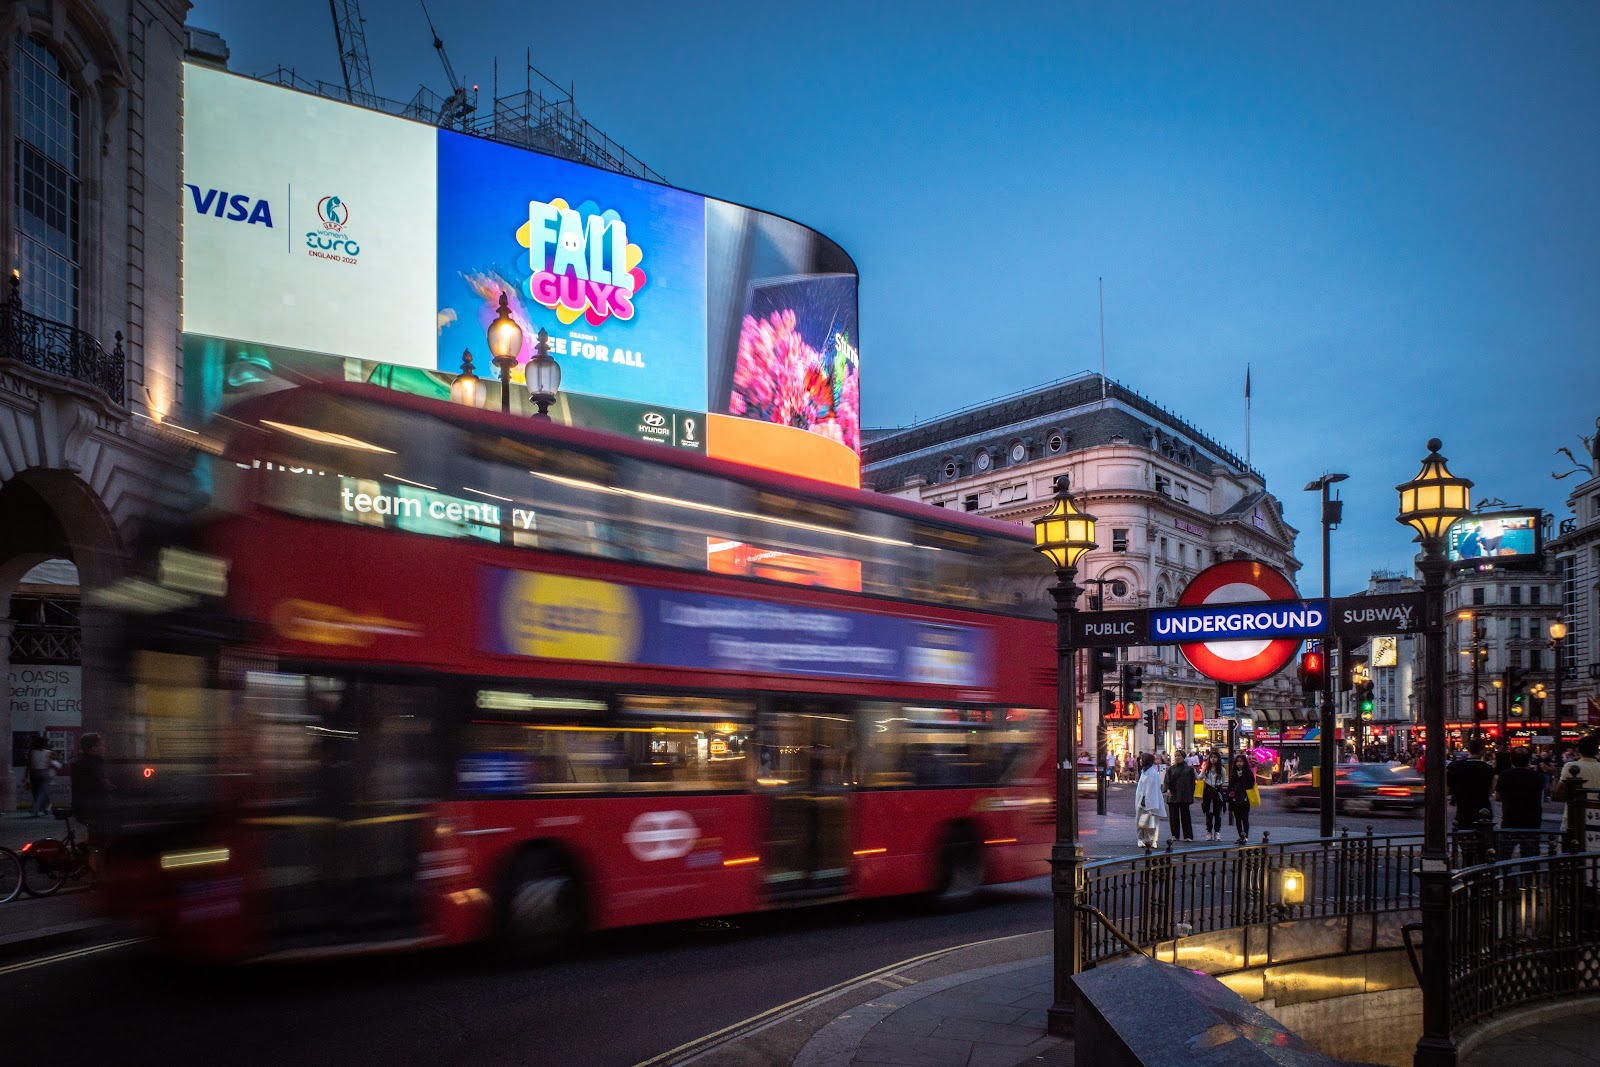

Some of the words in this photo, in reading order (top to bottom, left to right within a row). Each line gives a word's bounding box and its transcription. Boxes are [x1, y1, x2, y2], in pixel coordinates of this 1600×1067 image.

[184, 183, 273, 229] VISA
[308, 250, 341, 262] ENGLAND
[342, 256, 358, 265] 2022
[529, 201, 634, 290] FALL
[530, 271, 635, 321] GUYS
[569, 331, 593, 342] SEASON
[571, 341, 609, 363] FOR
[612, 349, 646, 369] ALL
[639, 425, 669, 435] HYUNDAI
[341, 487, 422, 519] team
[429, 500, 536, 530] centry
[1085, 622, 1135, 636] PUBLIC
[1156, 609, 1323, 635] UNDERGROUND
[1343, 605, 1414, 624] SUBWAY
[21, 670, 70, 684] OASIS
